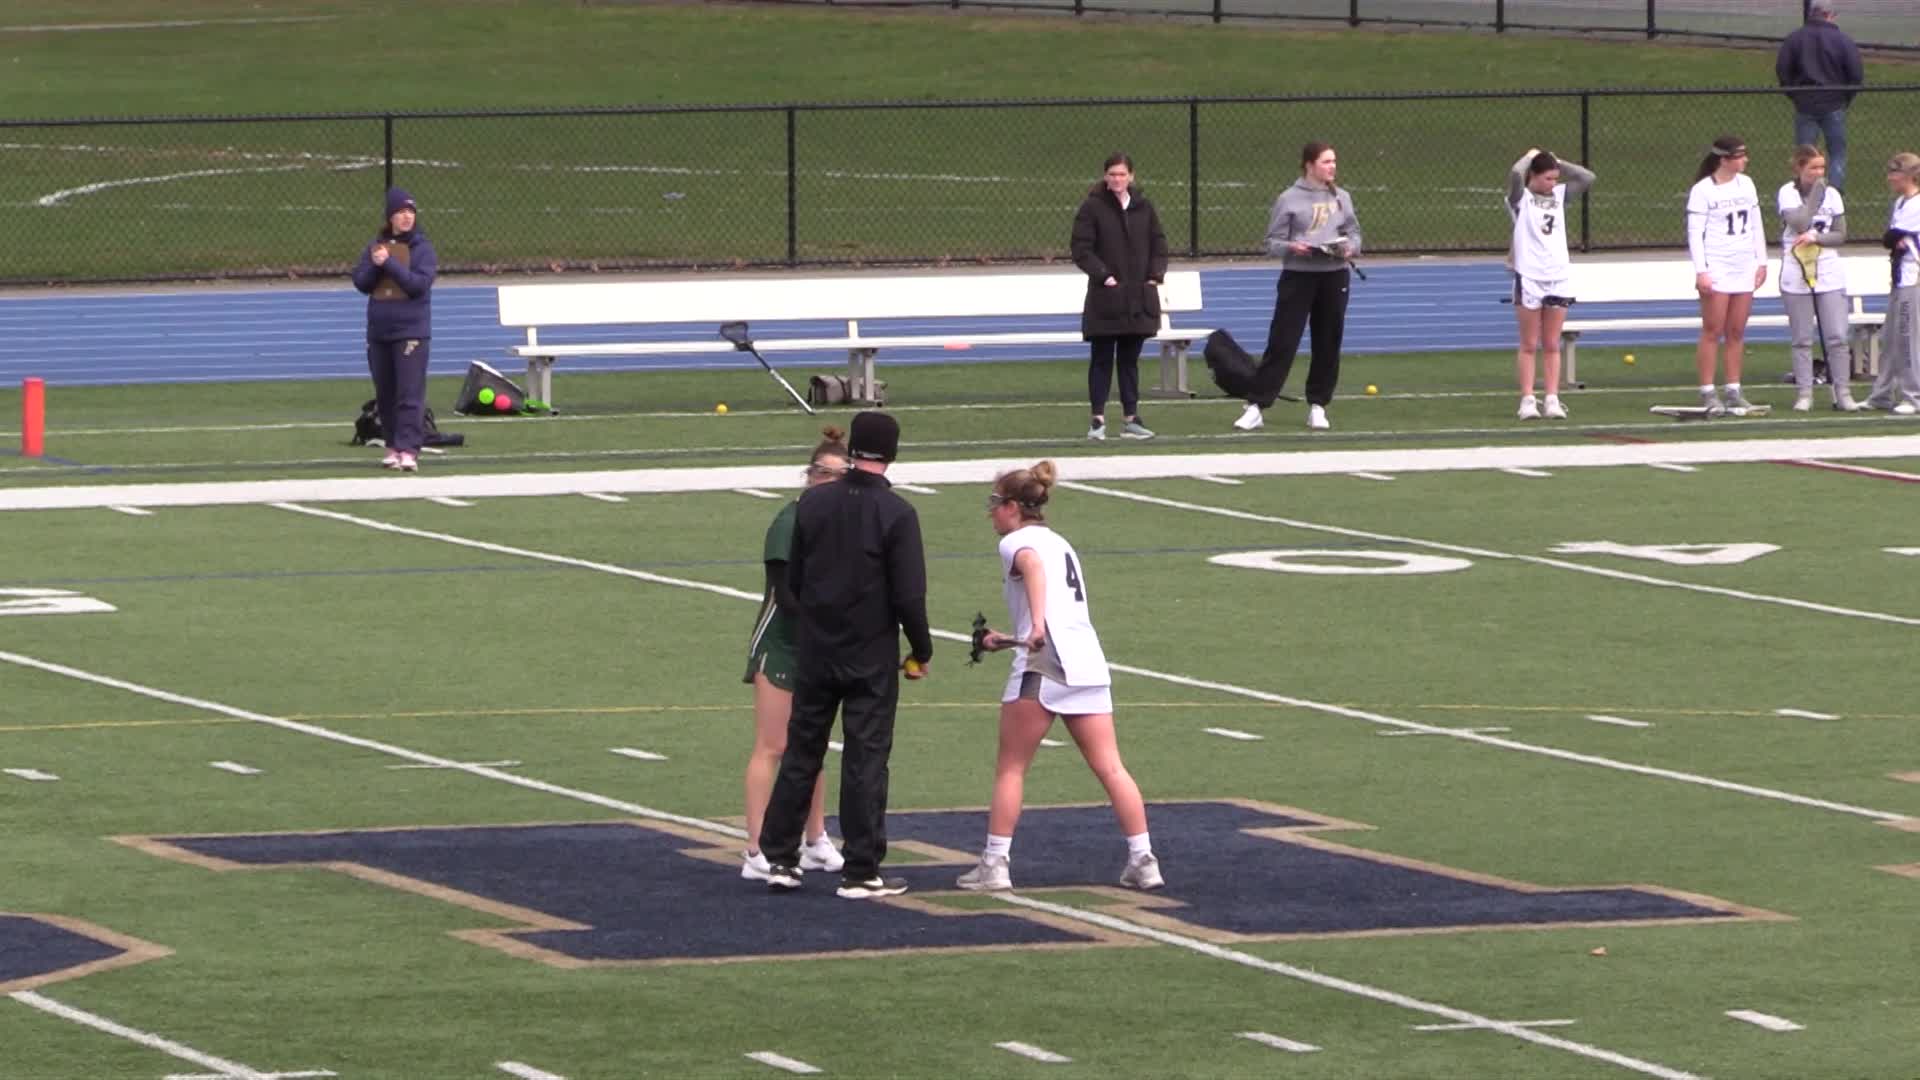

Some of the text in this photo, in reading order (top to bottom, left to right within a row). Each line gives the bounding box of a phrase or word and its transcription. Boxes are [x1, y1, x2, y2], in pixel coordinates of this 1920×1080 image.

[1540, 212, 1556, 236] 3
[1725, 208, 1749, 237] 17
[1064, 552, 1085, 602] 4
